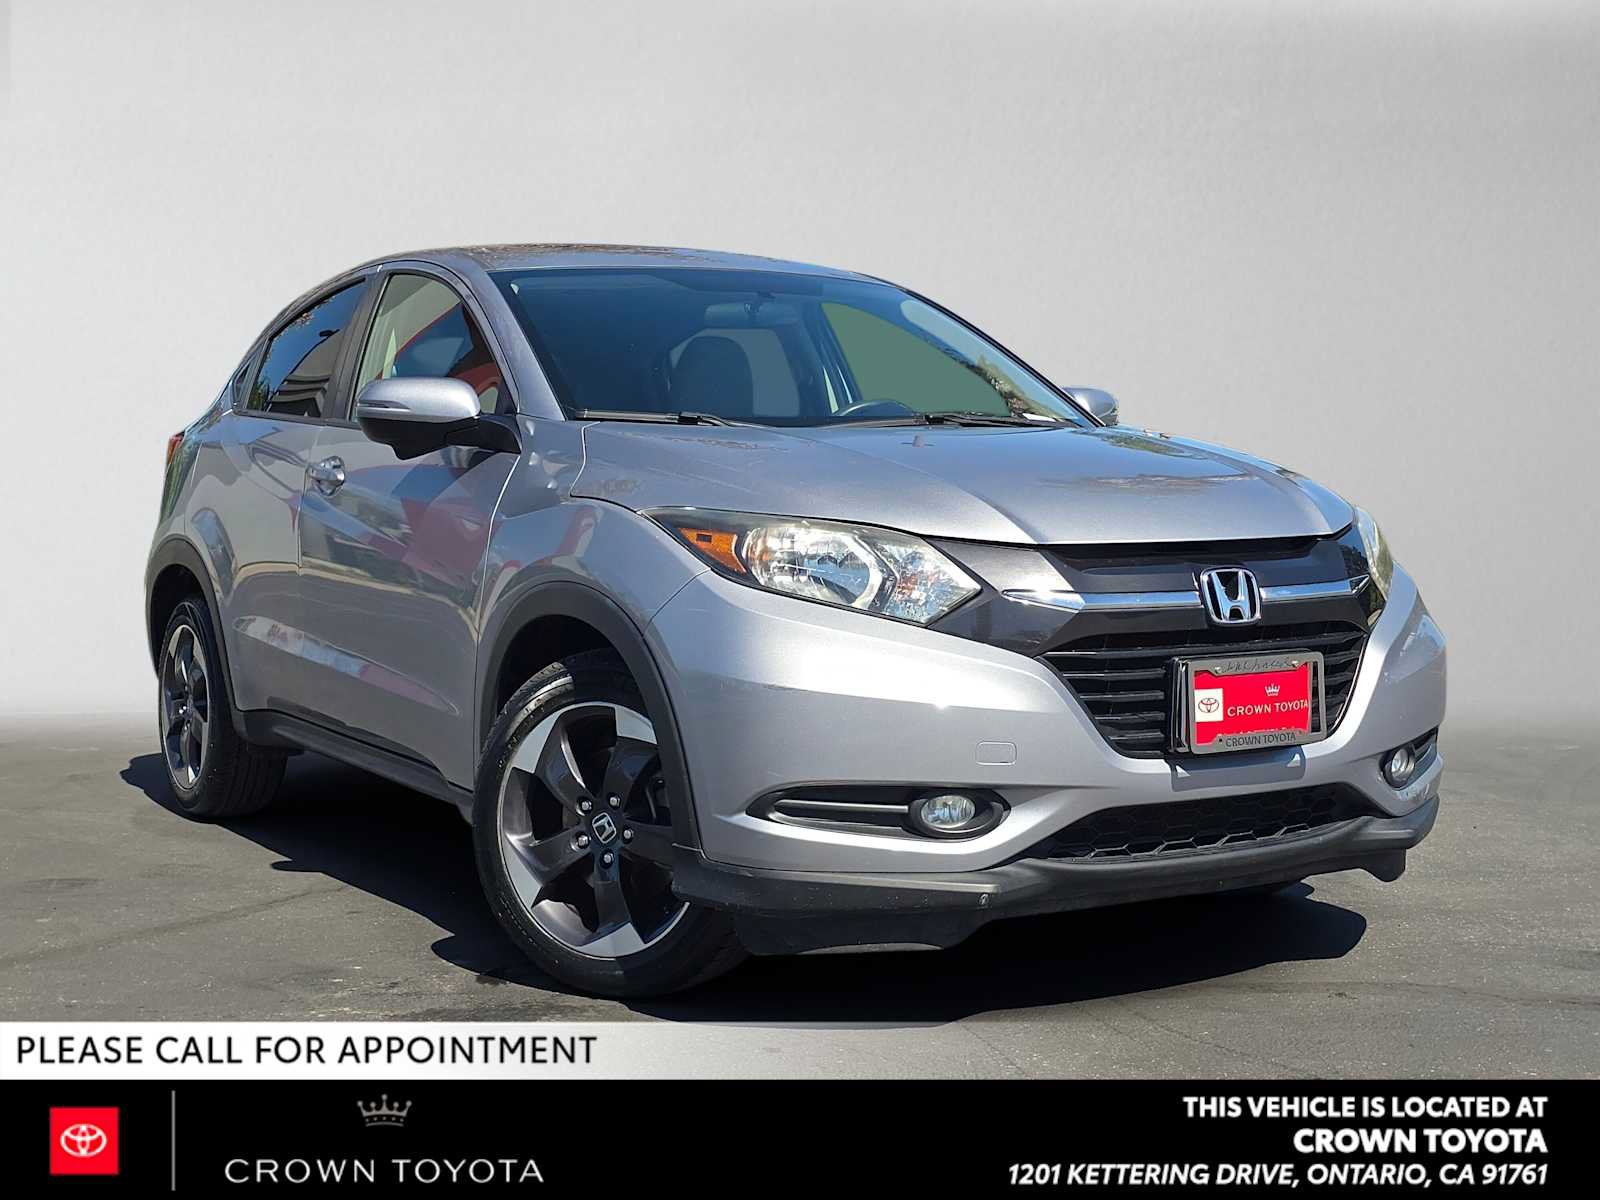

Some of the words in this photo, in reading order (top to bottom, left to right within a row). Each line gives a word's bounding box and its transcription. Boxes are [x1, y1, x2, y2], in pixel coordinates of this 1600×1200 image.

[1227, 703, 1272, 717] CROWN
[1274, 699, 1309, 713] TOYOTA
[1225, 736, 1261, 748] CROWN
[1263, 731, 1297, 744] TOYOTA
